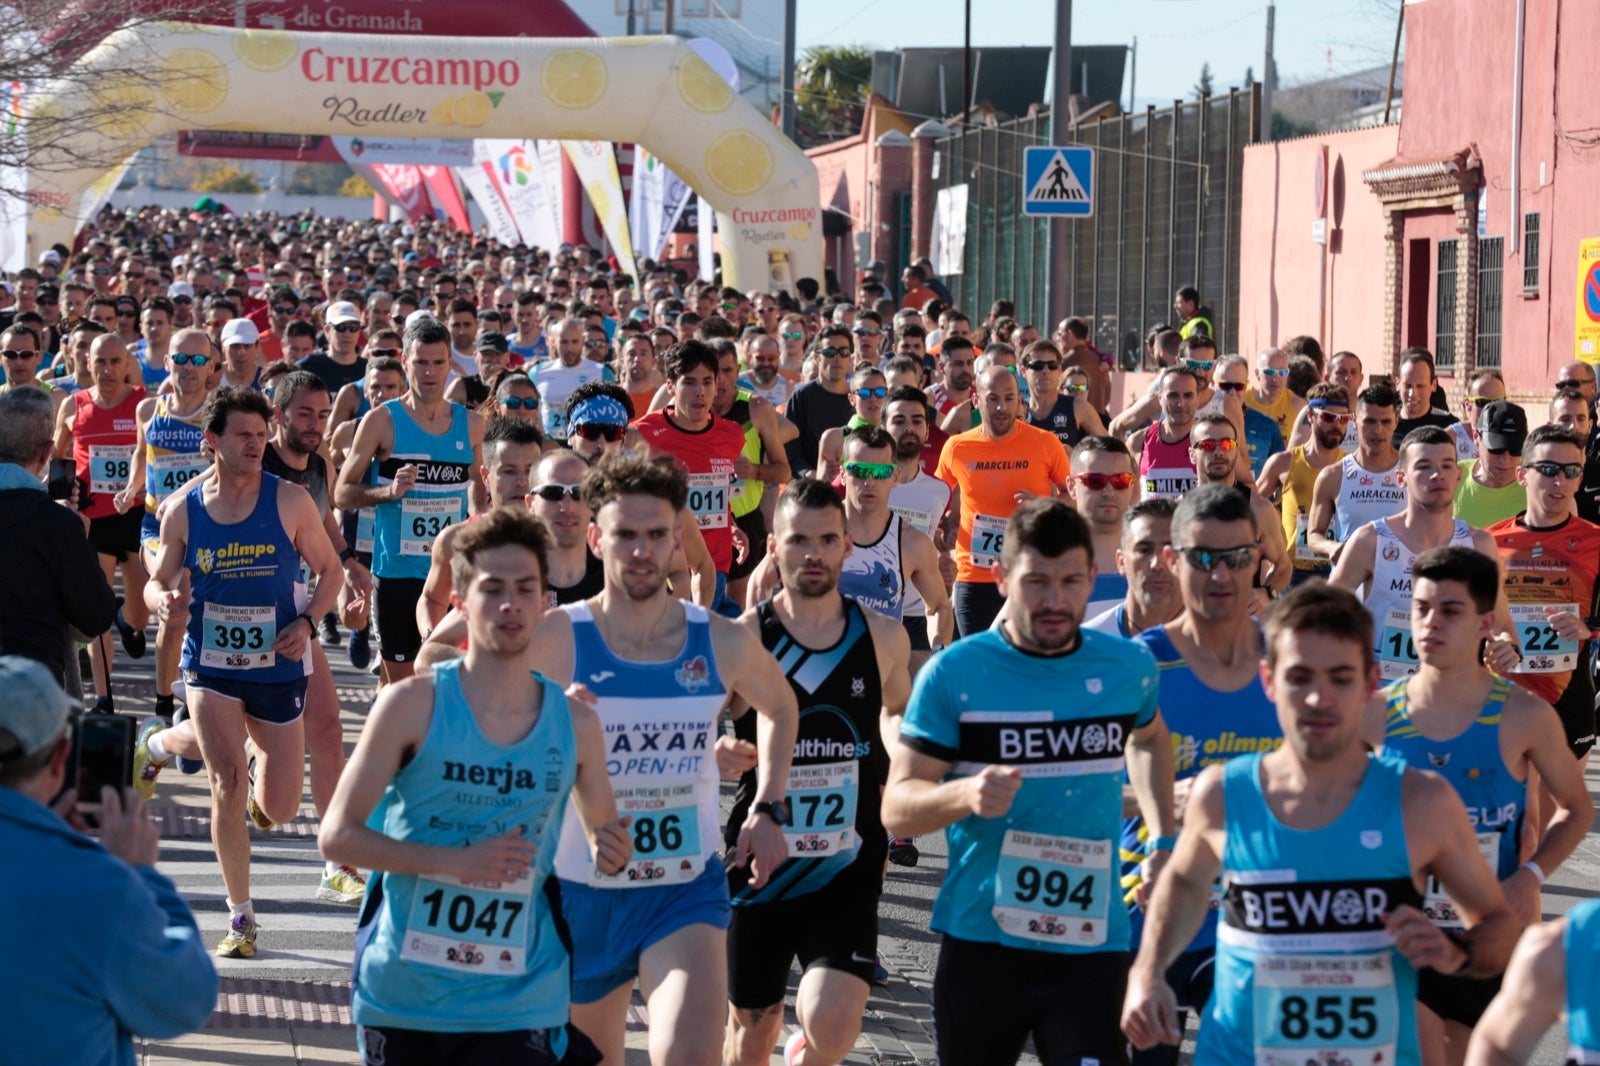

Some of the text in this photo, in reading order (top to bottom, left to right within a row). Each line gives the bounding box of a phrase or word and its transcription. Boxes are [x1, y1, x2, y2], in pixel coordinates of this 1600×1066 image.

[296, 6, 423, 31] de Granada
[301, 47, 520, 91] Cruzcampo
[323, 96, 429, 126] Radler
[732, 207, 816, 224] Cruzcampo
[150, 428, 203, 443] agustino
[105, 461, 129, 478] 98
[416, 463, 463, 481] EWOR
[975, 460, 1029, 471] MARCELINO
[1350, 489, 1404, 501] MARACENA
[413, 516, 452, 538] 634
[217, 542, 275, 558] olimpo
[982, 532, 1004, 553] 78
[216, 558, 253, 568] deportes
[214, 625, 264, 650] 393
[1524, 626, 1559, 651] 22
[602, 724, 626, 732] UB
[443, 760, 536, 794] nerja
[634, 815, 682, 853] 86
[1015, 866, 1094, 911] 994
[422, 889, 523, 938] 1047
[1280, 996, 1377, 1040] 855
